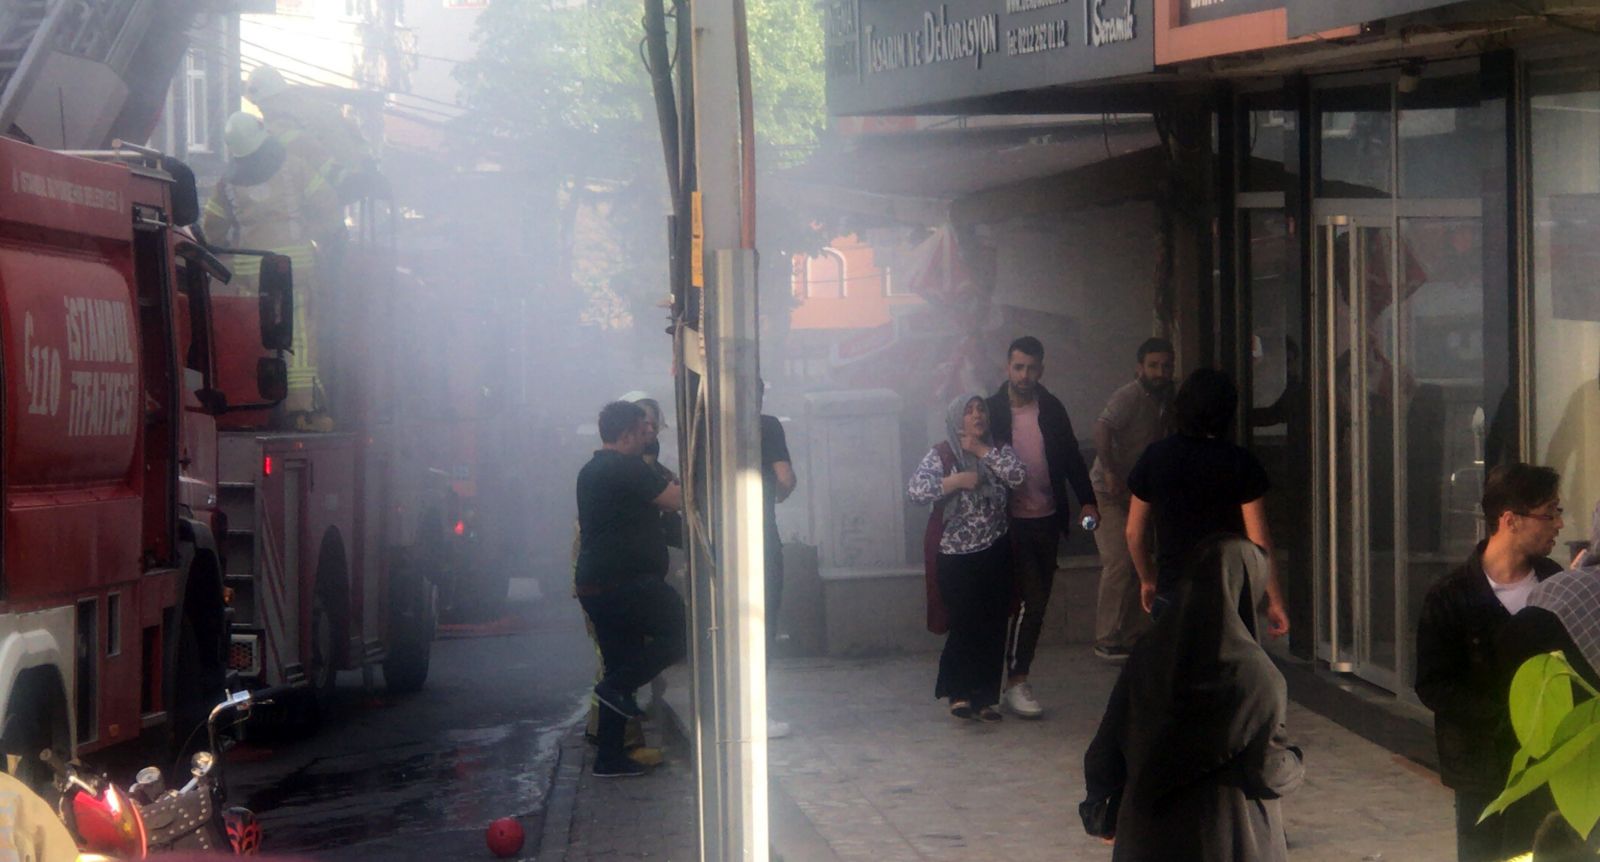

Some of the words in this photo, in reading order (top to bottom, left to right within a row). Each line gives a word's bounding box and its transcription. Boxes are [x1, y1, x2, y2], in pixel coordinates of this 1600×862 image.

[864, 25, 905, 73] TASARIM
[908, 31, 920, 67] VE
[64, 295, 134, 364] İSTANBUL
[28, 345, 61, 417] 110
